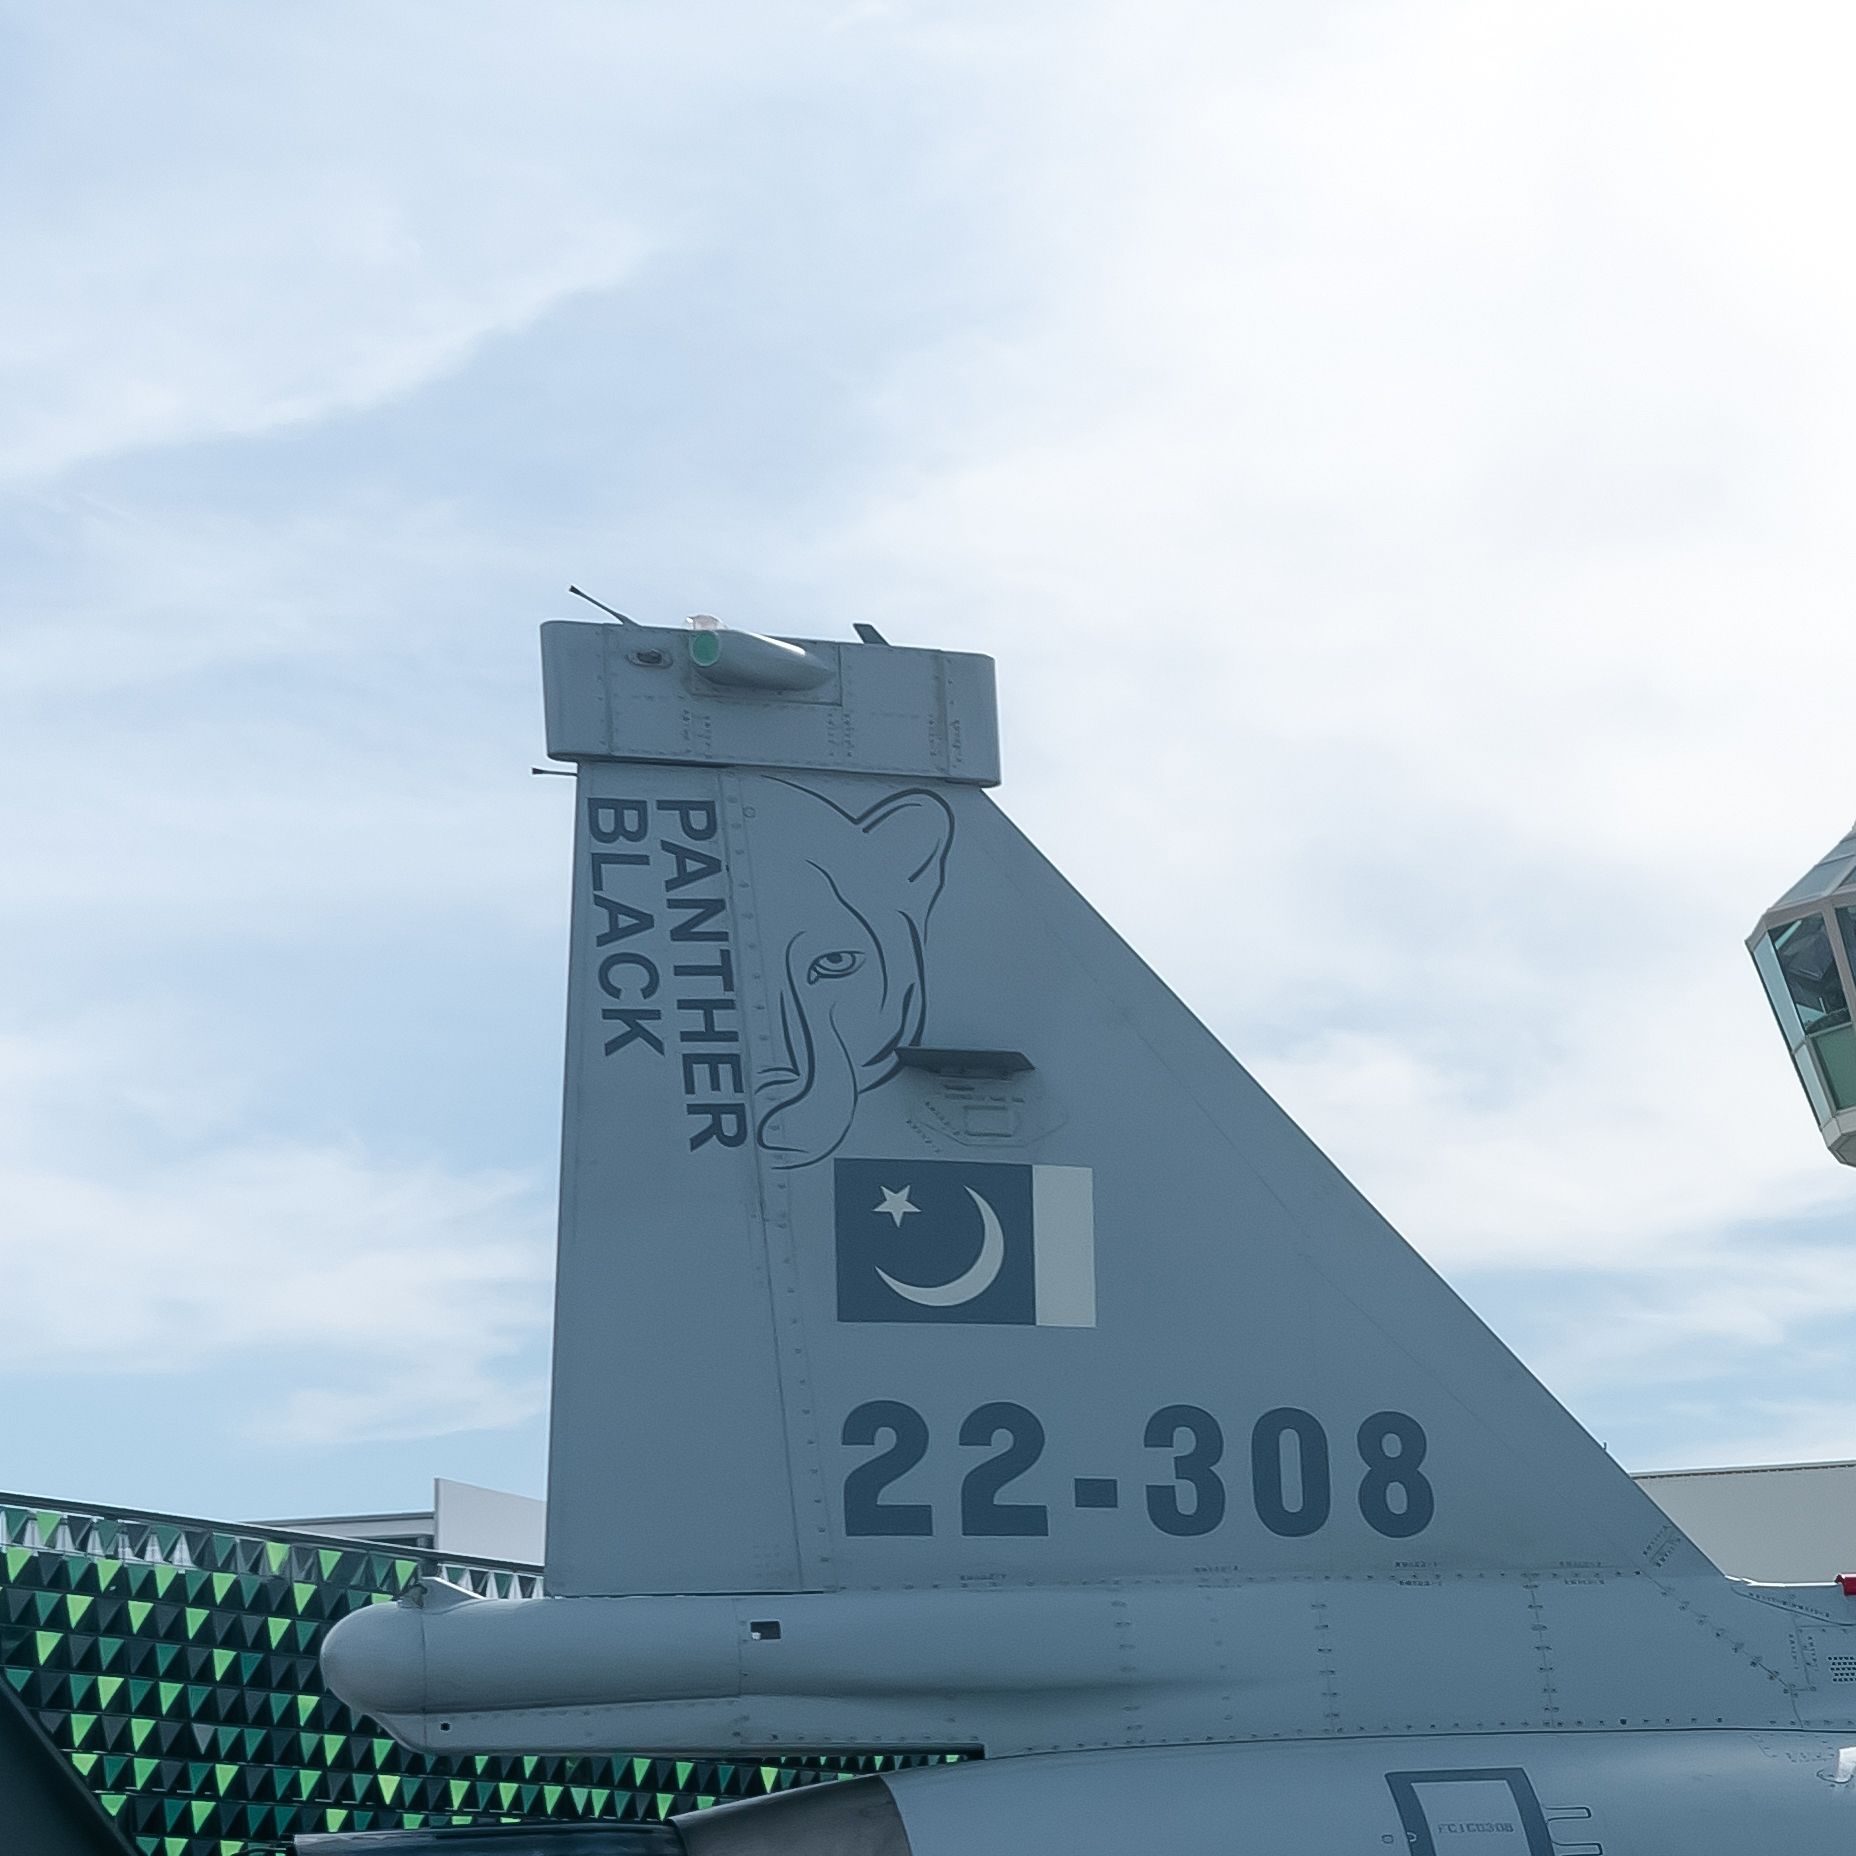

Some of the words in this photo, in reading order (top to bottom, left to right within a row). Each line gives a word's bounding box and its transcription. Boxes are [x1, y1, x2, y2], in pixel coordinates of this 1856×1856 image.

[587, 797, 665, 1057] BLACK
[656, 799, 748, 1152] PANTHER
[841, 1400, 1435, 1538] 22-308
